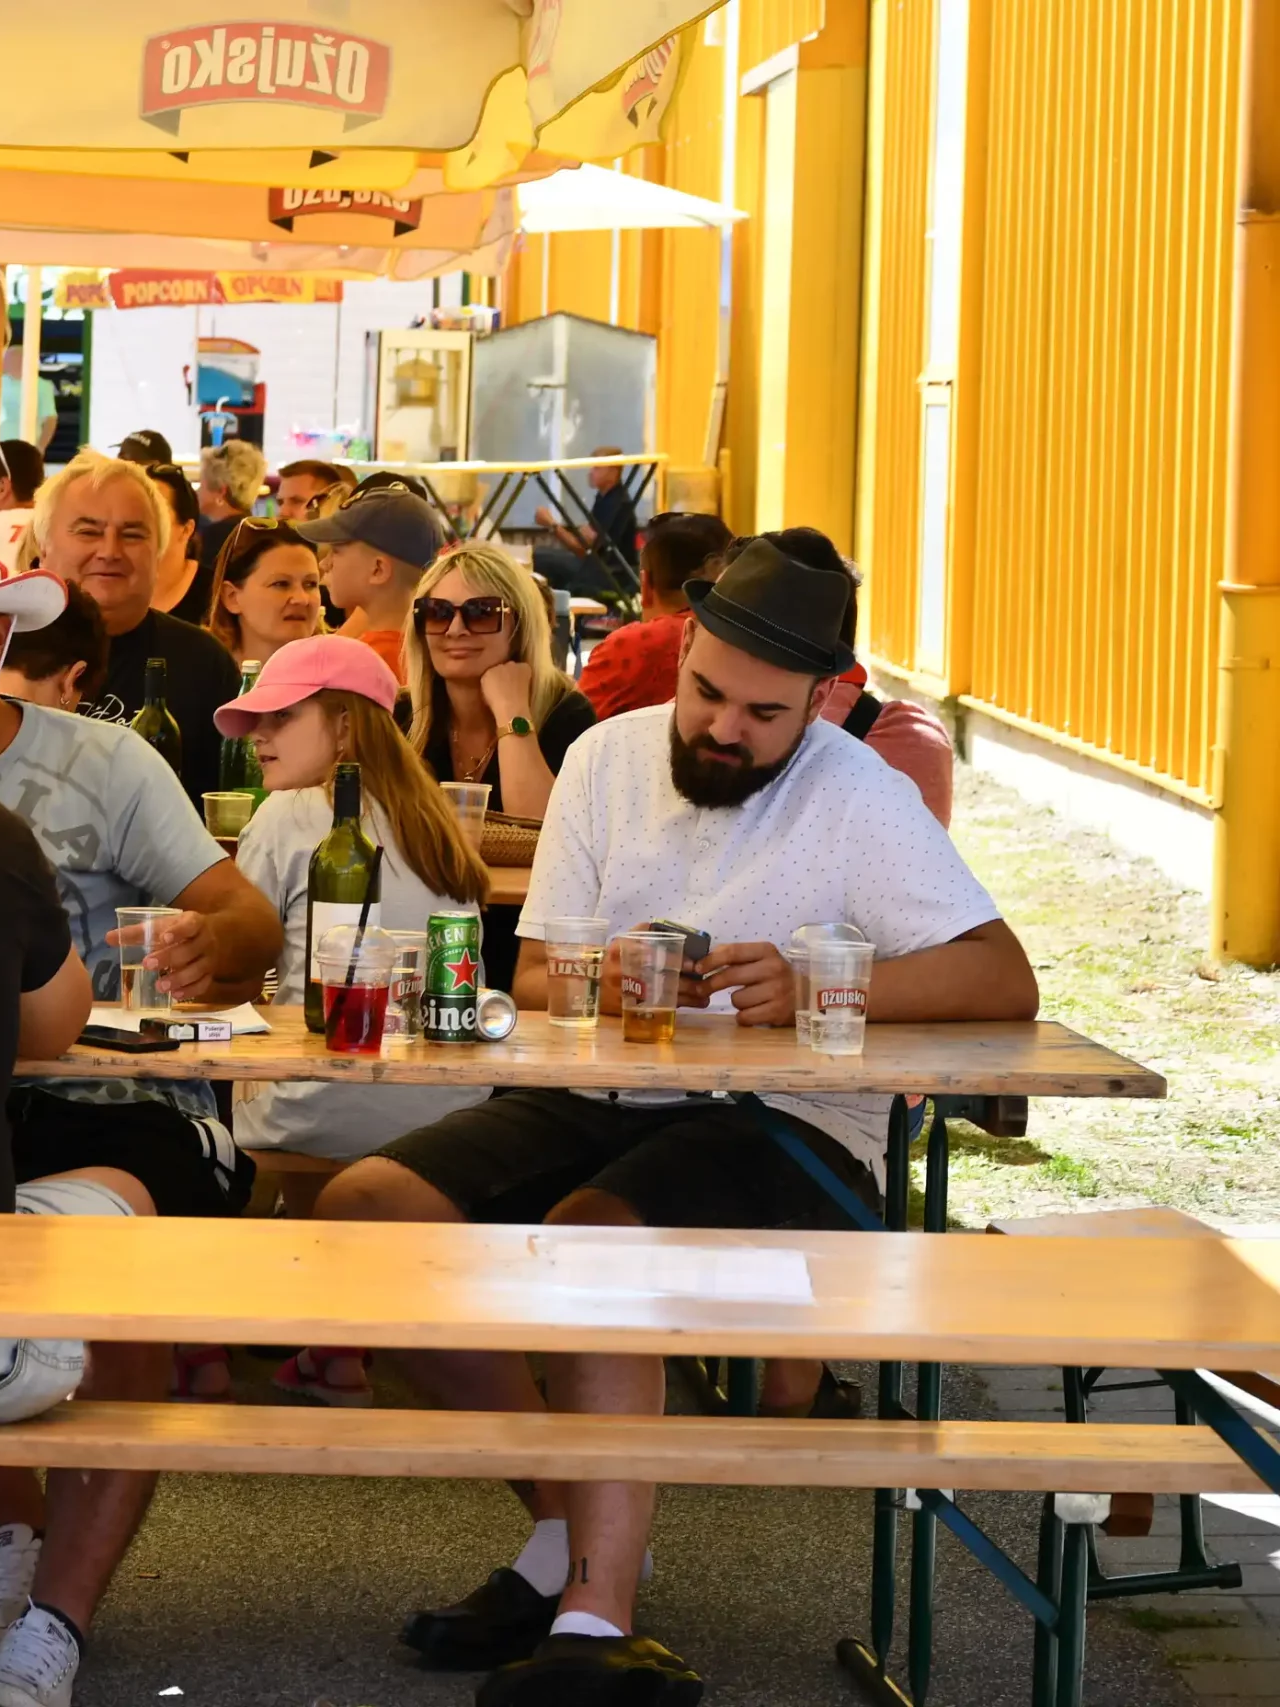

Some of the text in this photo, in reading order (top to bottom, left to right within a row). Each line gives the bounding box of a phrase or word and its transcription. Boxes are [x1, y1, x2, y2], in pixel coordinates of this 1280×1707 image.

[122, 280, 208, 305] POPCORN
[230, 276, 302, 297] OPCORN
[420, 999, 476, 1031] eine
